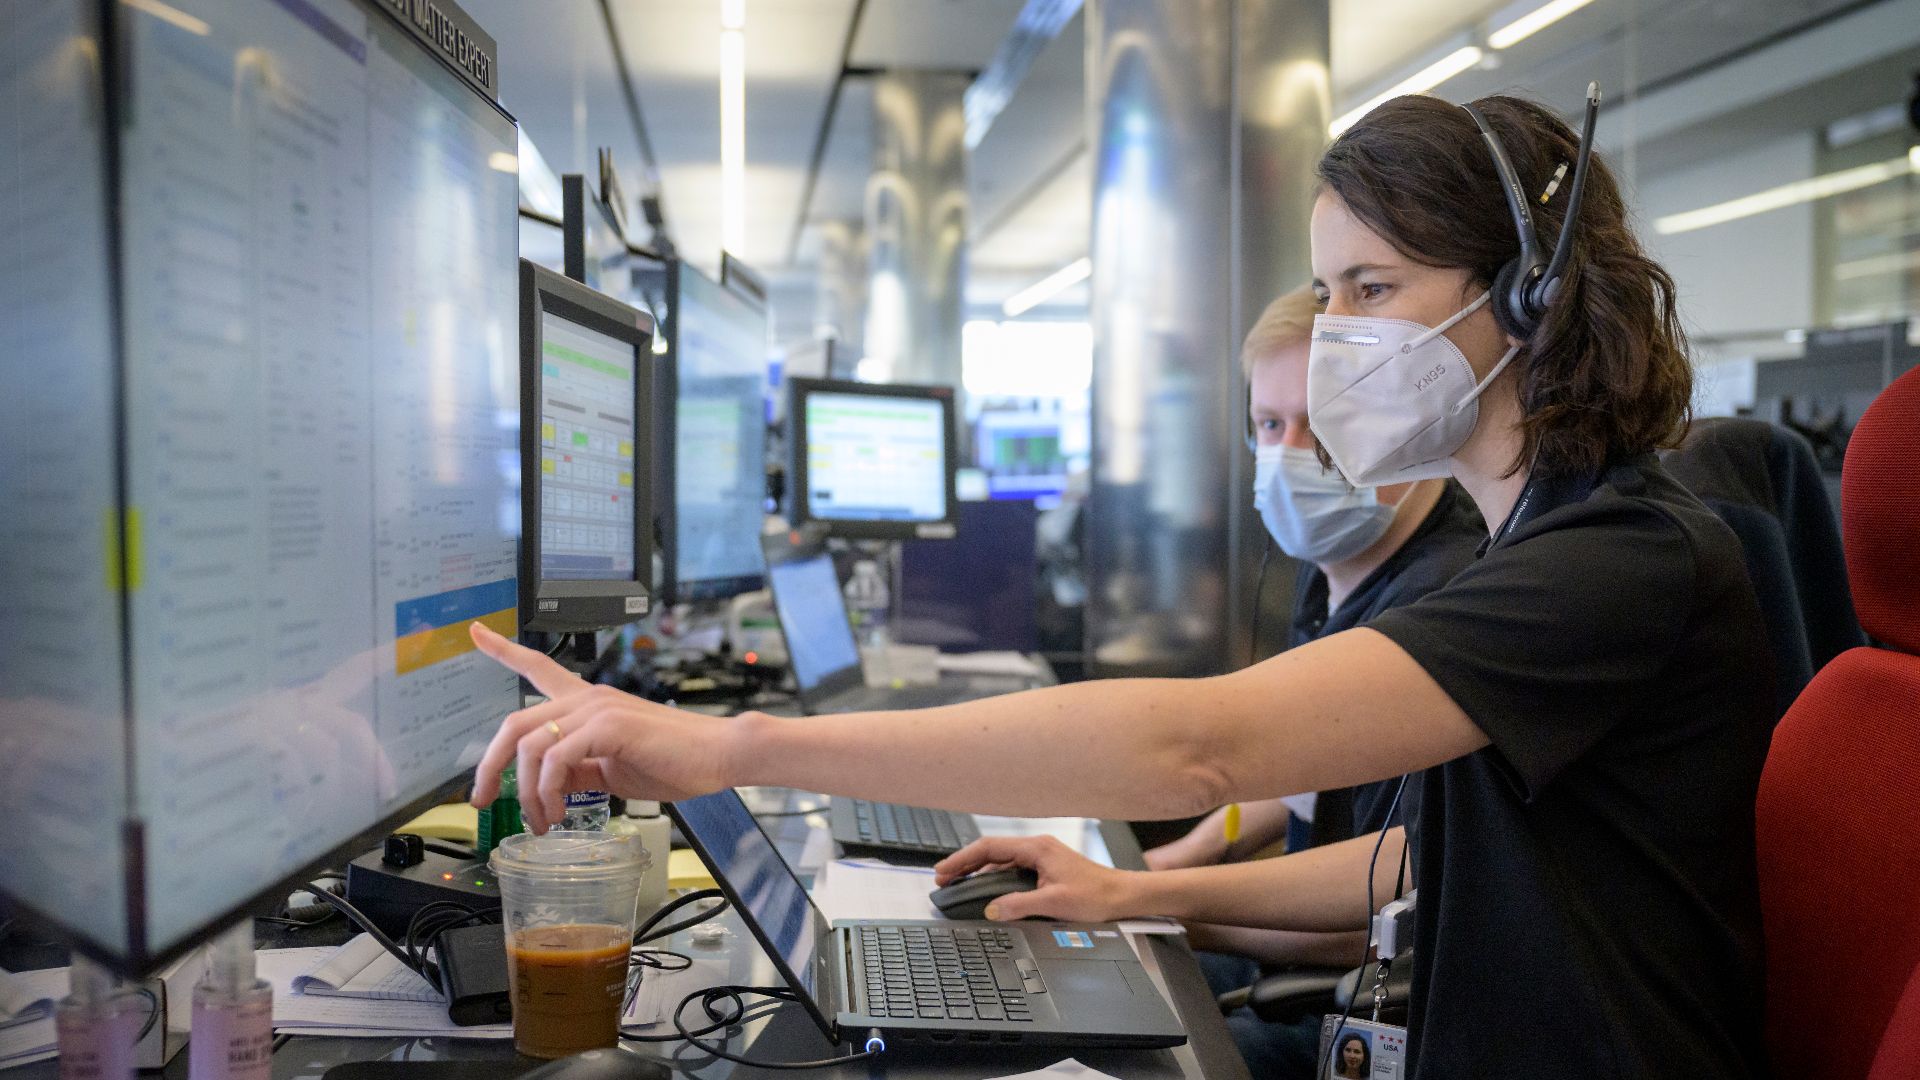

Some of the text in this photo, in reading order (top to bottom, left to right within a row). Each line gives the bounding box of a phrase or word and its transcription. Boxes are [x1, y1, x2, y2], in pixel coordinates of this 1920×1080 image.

[413, 0, 492, 88] MATTER EXPERT
[1413, 363, 1446, 391] KN95
[1383, 1043, 1399, 1053] USA
